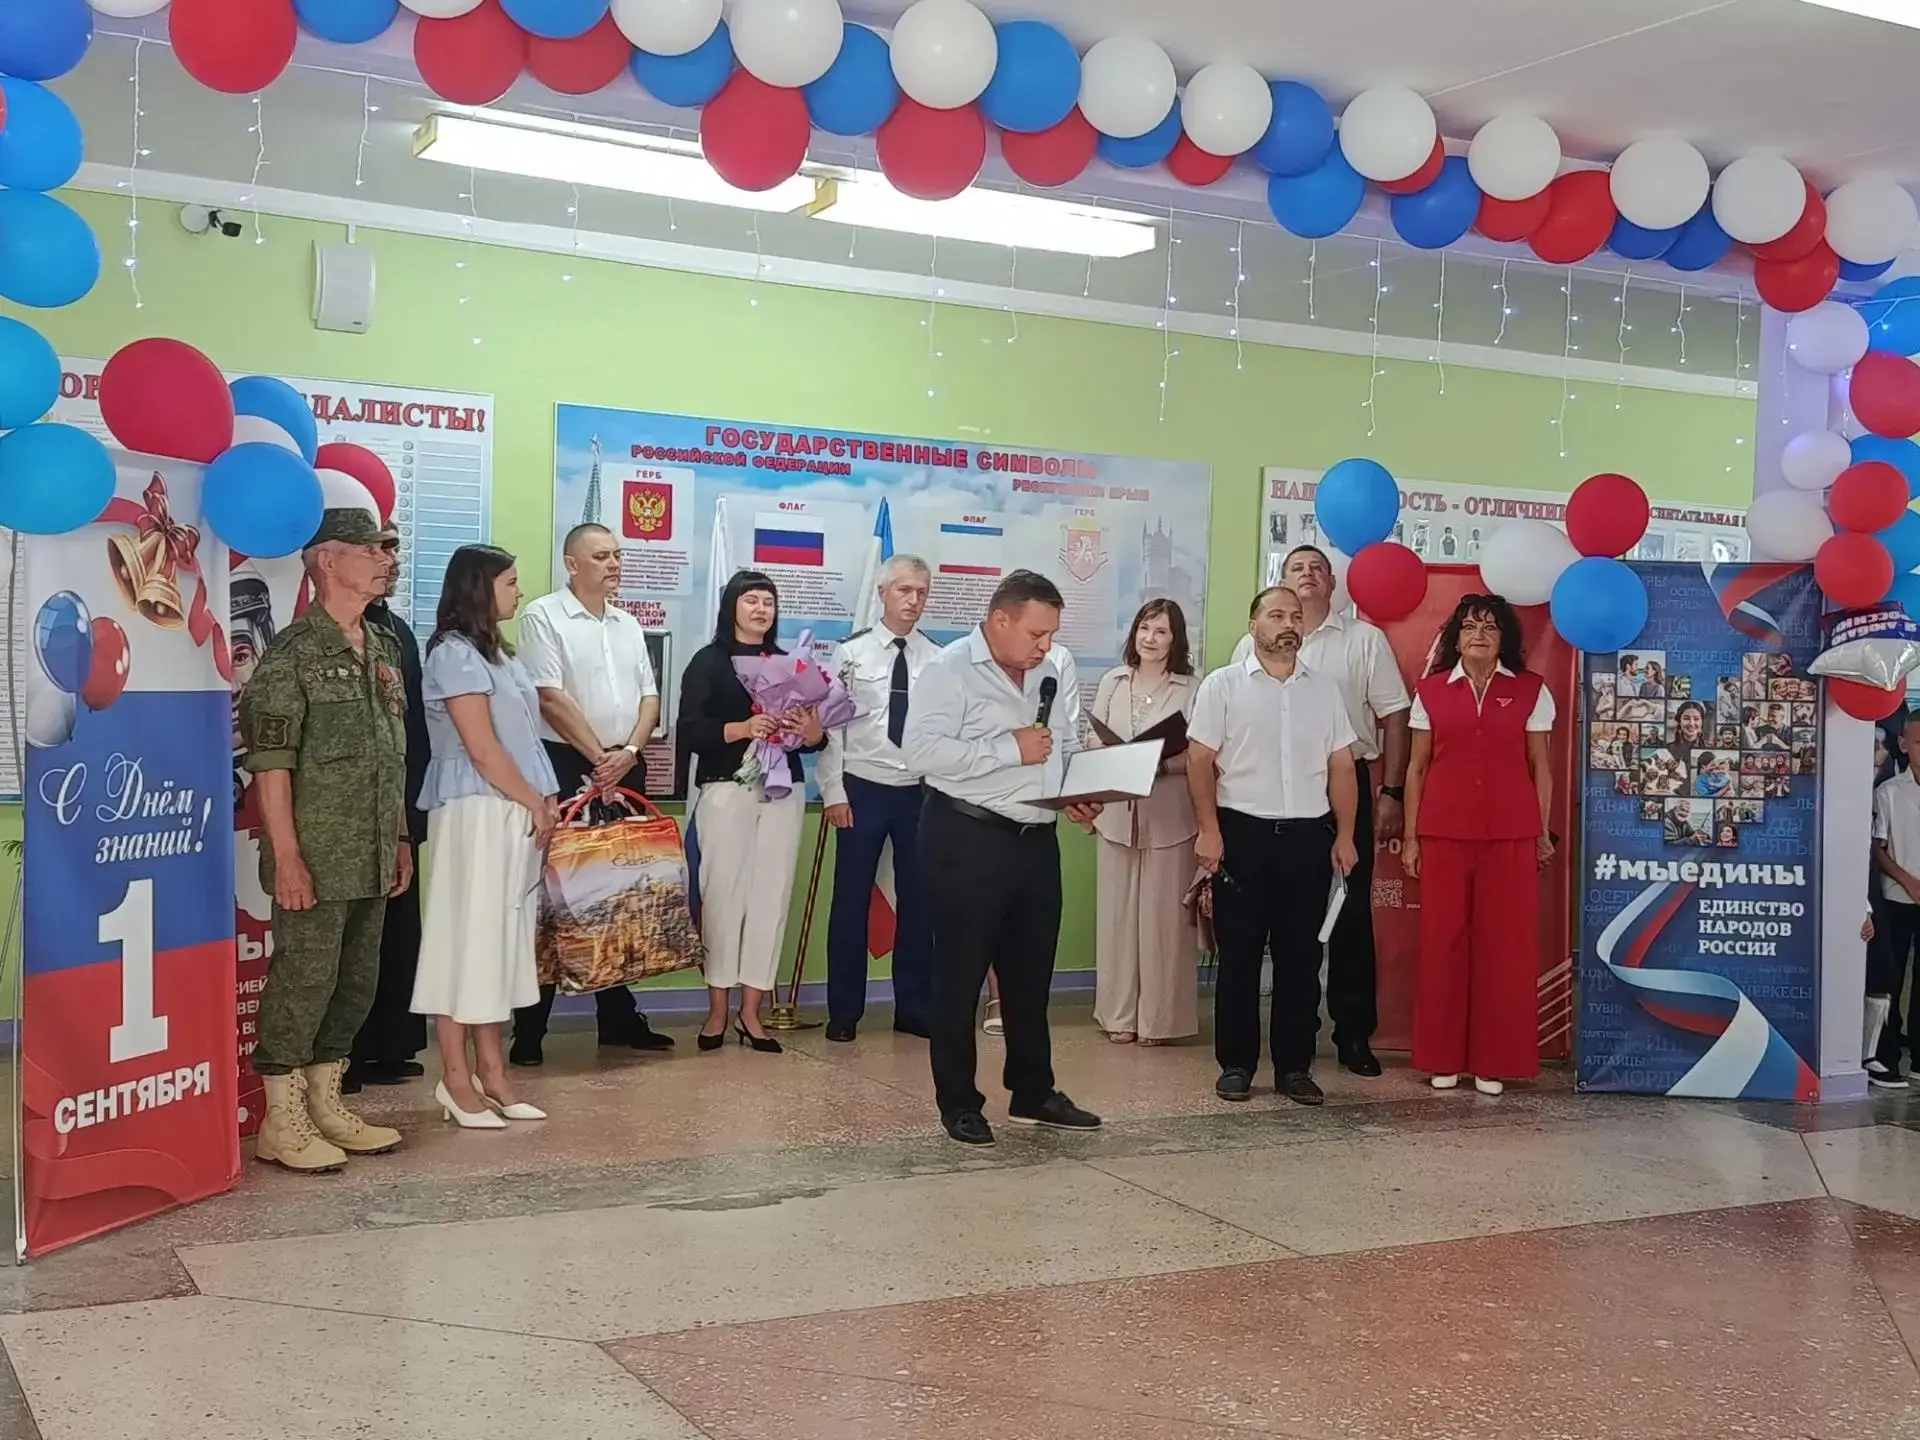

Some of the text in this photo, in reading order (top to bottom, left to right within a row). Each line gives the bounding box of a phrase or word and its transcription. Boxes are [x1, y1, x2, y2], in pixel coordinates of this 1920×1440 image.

[302, 394, 486, 433] ДАЛИСТЫ!
[631, 444, 851, 477] РОССИЙСКОЙ ФЕДЕРАЦИИ
[706, 426, 968, 468] ГОСУДАРСТВЕННЫЕ
[635, 469, 663, 480] ГЕРБ
[778, 501, 806, 512] ФЛАГ
[963, 514, 987, 524] ФЛАГ
[1651, 506, 1740, 528] СПИТАТЕЛЬНАЯ
[607, 600, 662, 609] ЕЗИДЕНТ
[39, 752, 195, 825] С Днём
[94, 797, 213, 865] знаний!
[1594, 853, 1806, 889] #мыедины
[1698, 899, 1805, 918] ЕДИНСТВО
[1698, 919, 1792, 938] НАРОДОВ
[1698, 939, 1777, 957] РОССИИ
[98, 878, 169, 1064] 1
[54, 1061, 212, 1135] СЕНТЯБРЯ
